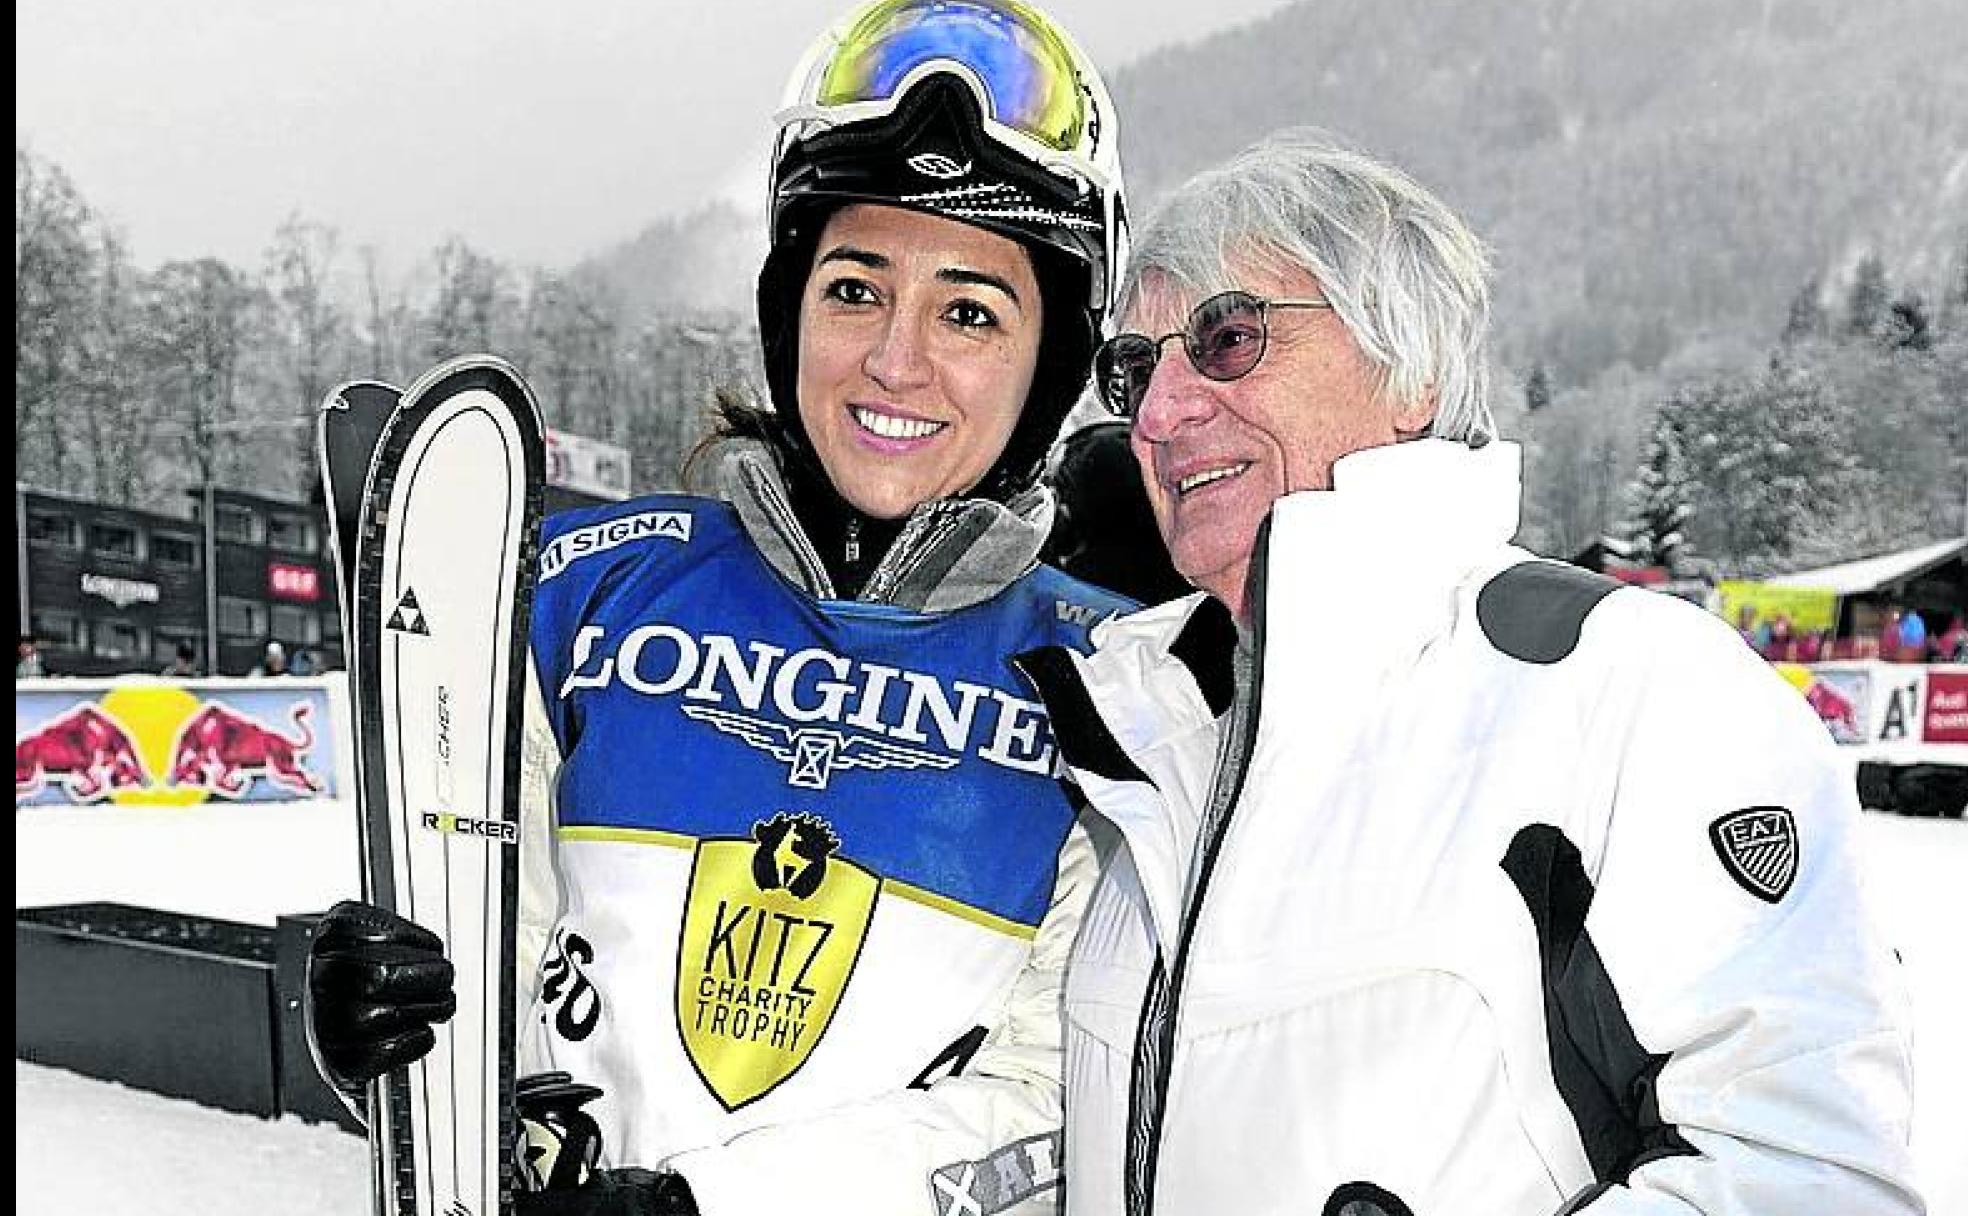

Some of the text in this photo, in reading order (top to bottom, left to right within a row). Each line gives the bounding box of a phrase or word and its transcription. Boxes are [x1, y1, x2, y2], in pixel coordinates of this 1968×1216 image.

[573, 515, 684, 551] SIGNA
[560, 624, 1060, 778] LONGINE
[1730, 814, 1780, 842] EA7
[704, 900, 835, 996] KITZ
[699, 975, 812, 1019] CHARITY
[696, 998, 807, 1052] TROPHY
